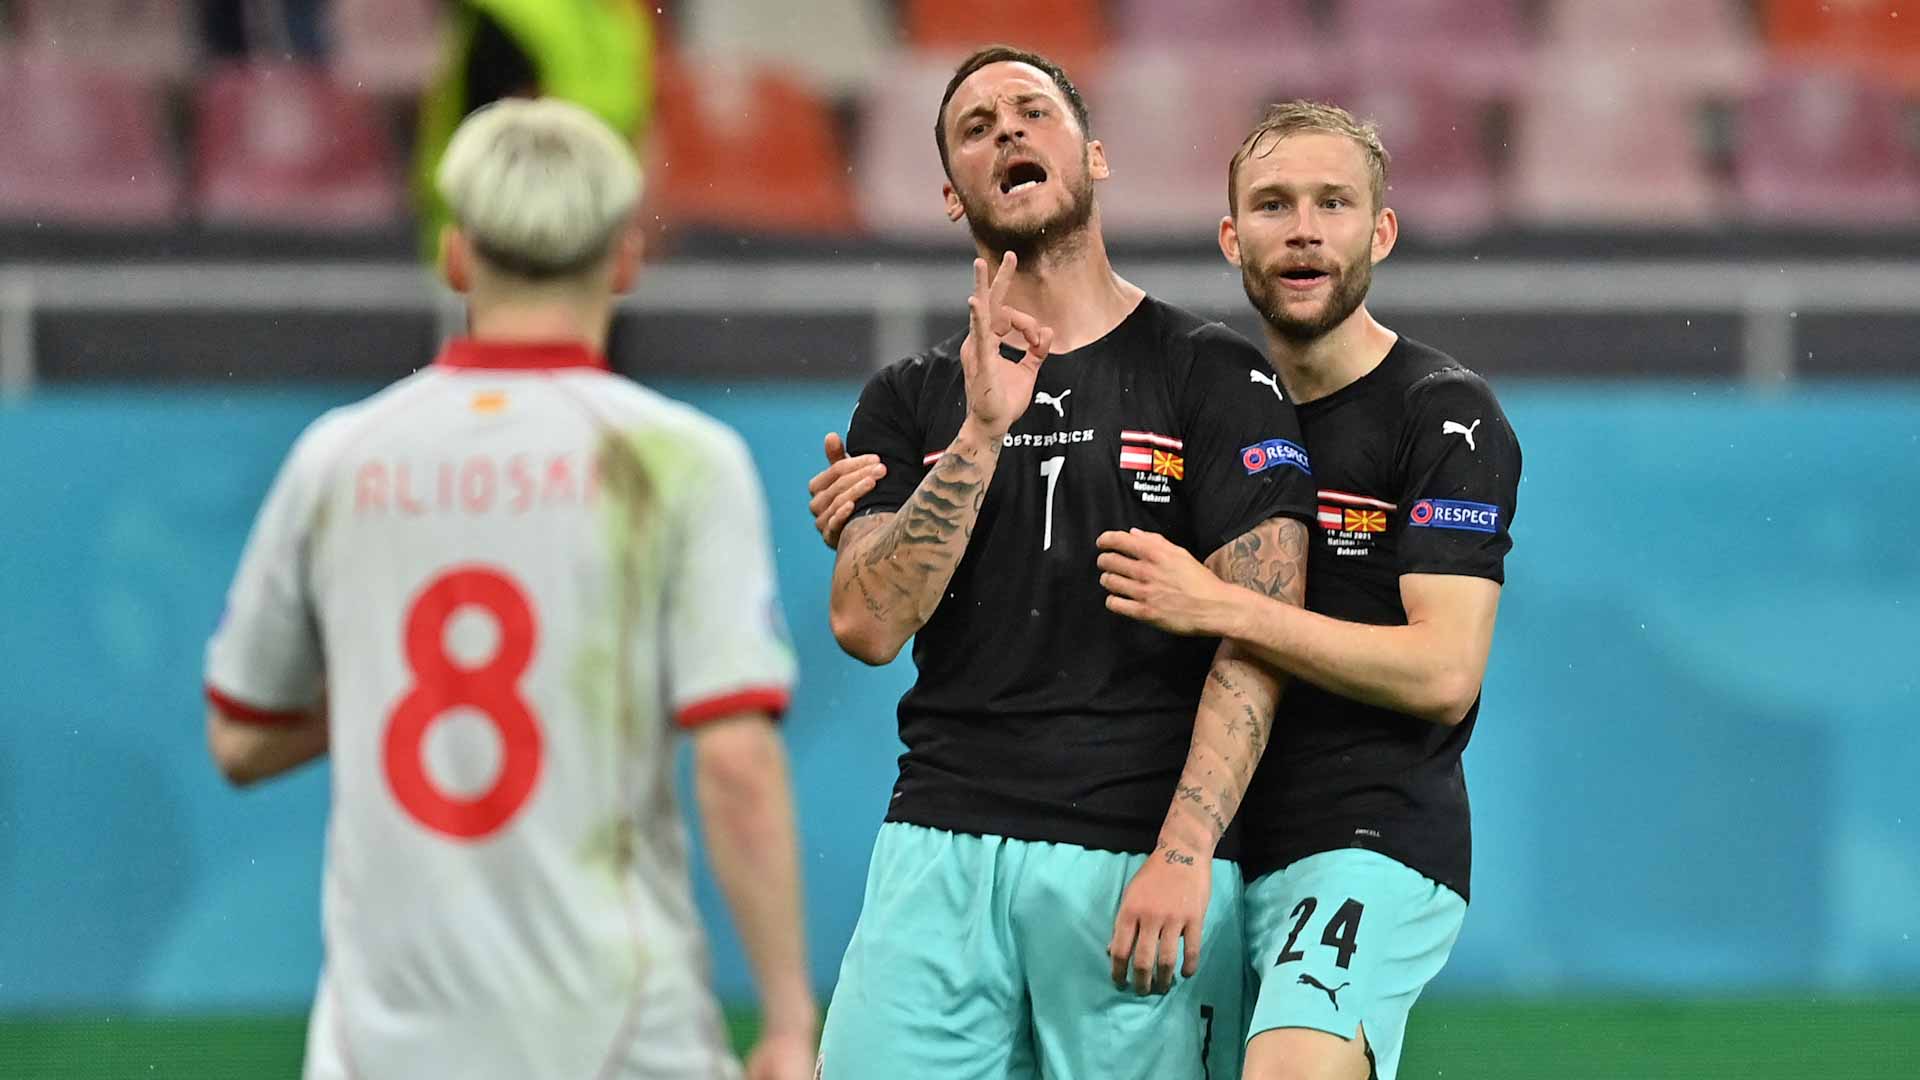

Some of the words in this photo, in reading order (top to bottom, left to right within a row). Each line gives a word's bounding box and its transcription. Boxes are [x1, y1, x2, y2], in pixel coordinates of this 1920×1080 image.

[1434, 507, 1498, 525] RESPECT
[381, 562, 544, 844] 8
[1273, 896, 1365, 970] 24
